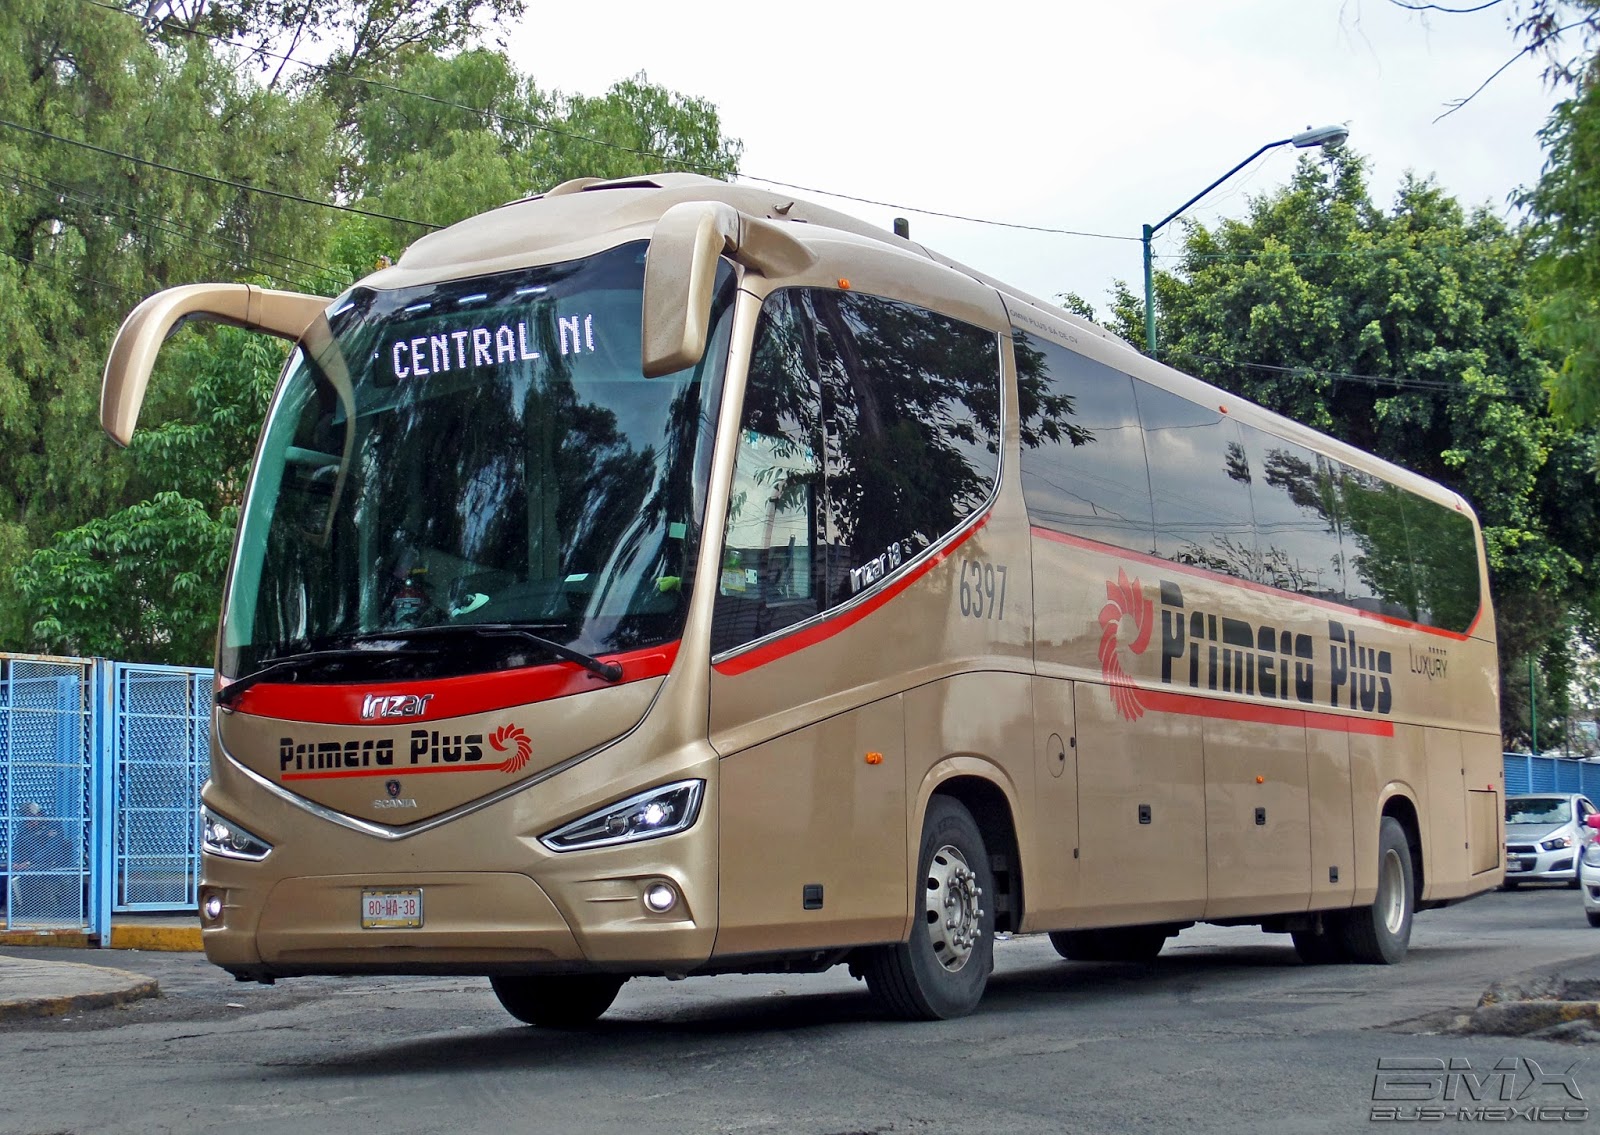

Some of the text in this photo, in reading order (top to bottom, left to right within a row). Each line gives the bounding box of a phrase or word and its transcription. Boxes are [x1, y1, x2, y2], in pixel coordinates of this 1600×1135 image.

[392, 322, 541, 379] CENTRAL
[959, 559, 1008, 621] 6397
[1159, 579, 1392, 715] Primera Plus
[1408, 643, 1448, 681] LUXURY
[280, 729, 483, 771] Primera Plus
[373, 798, 418, 809] SCANIA
